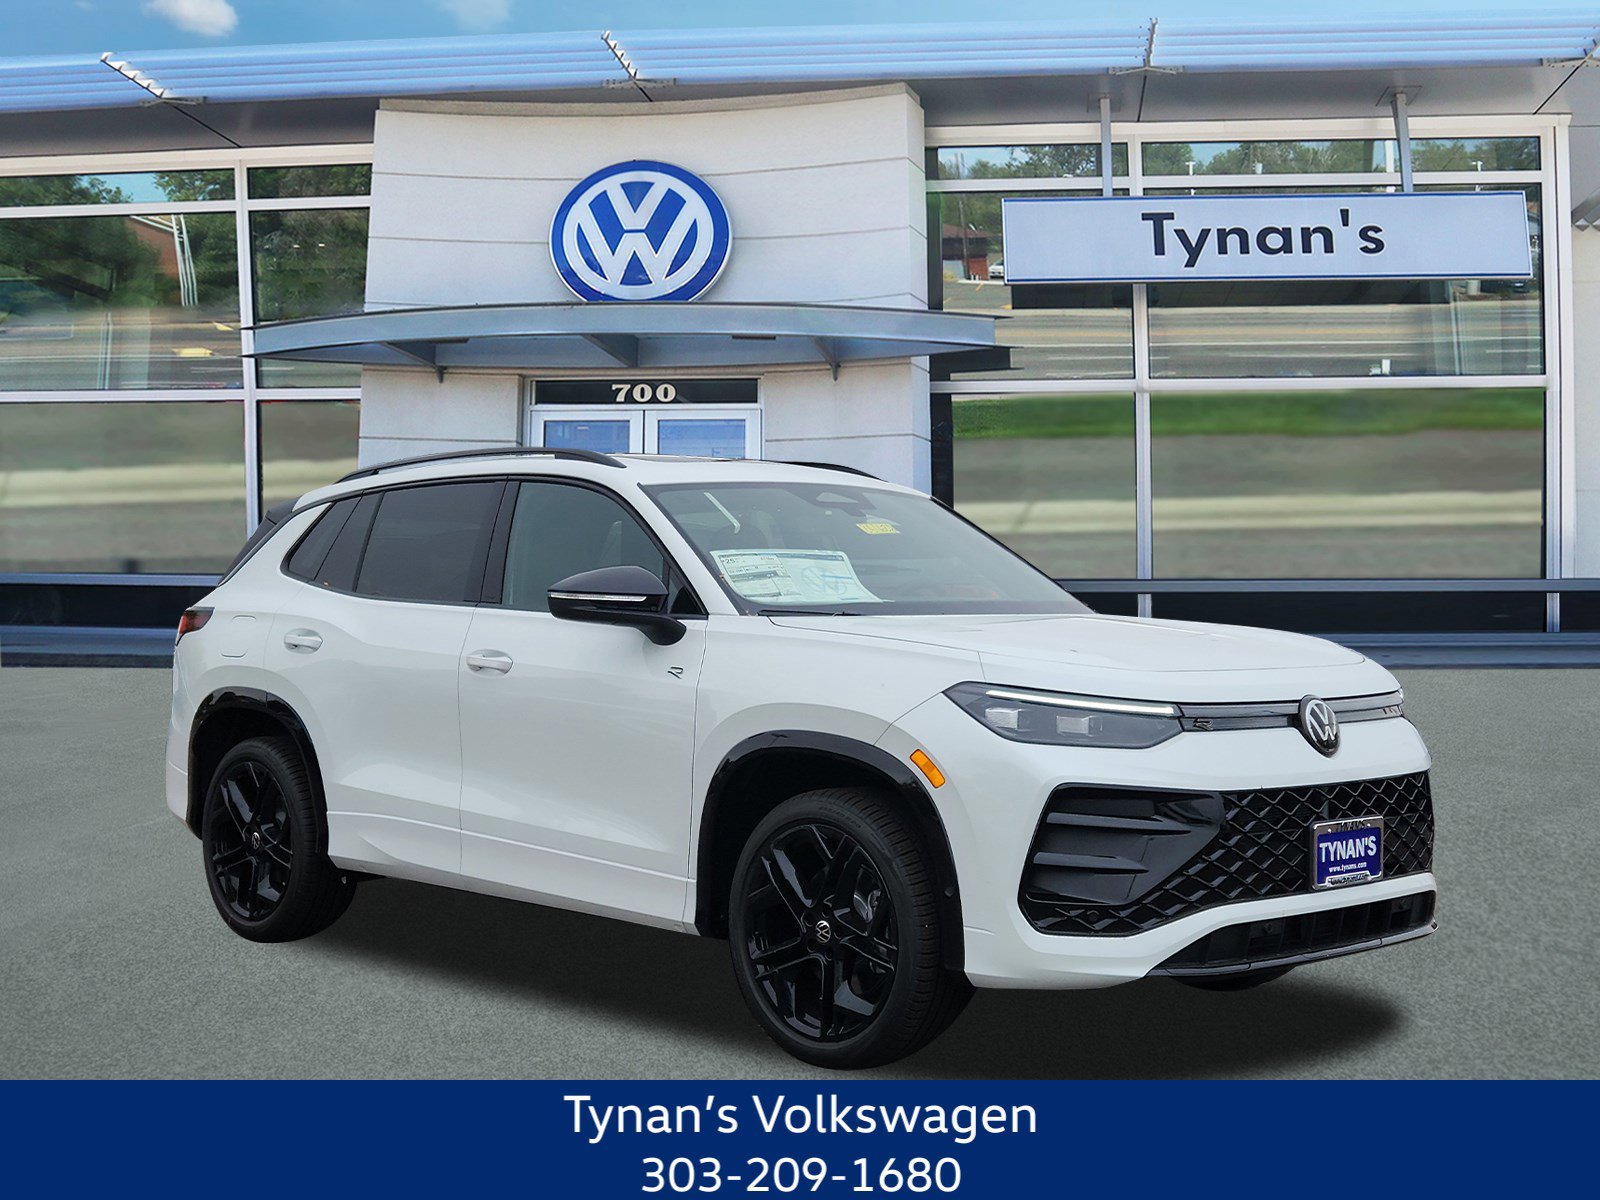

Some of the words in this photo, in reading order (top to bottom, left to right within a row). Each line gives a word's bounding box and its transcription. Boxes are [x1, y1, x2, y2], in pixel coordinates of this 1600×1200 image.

[1141, 208, 1386, 268] Tynan's
[611, 383, 677, 403] 700
[1319, 835, 1377, 863] TYNAN'S
[1328, 861, 1367, 873] www.tynans.com
